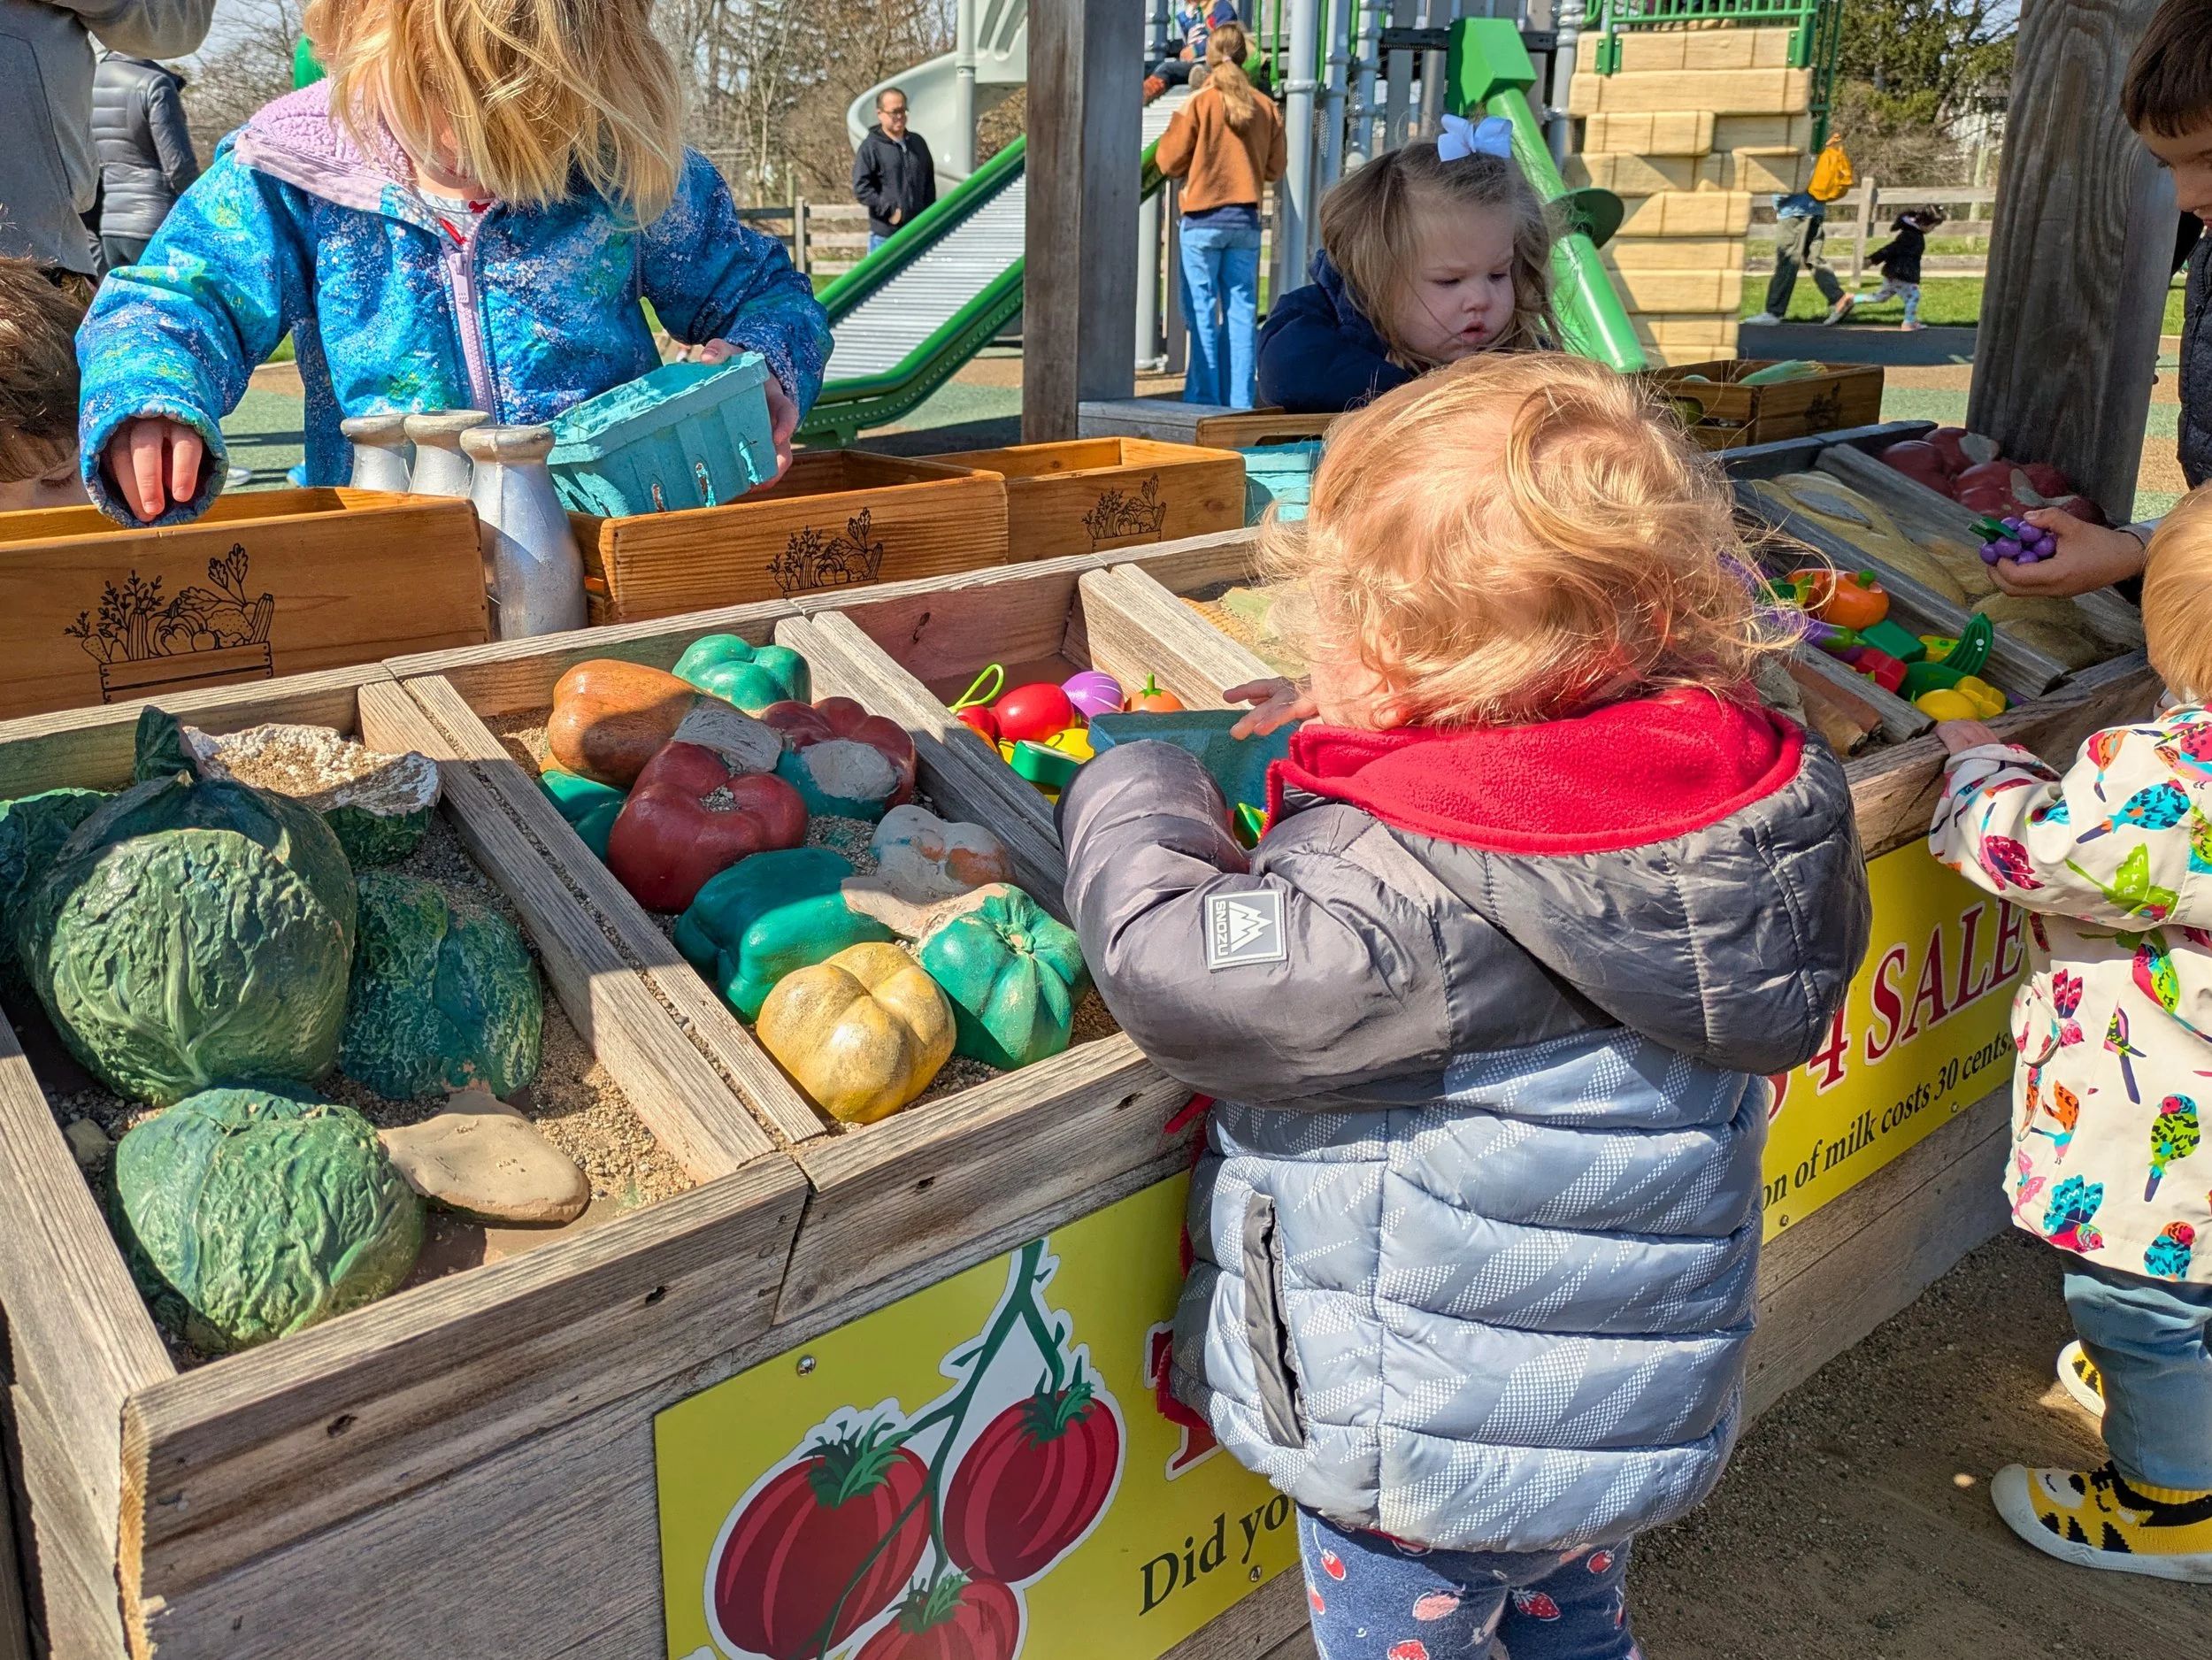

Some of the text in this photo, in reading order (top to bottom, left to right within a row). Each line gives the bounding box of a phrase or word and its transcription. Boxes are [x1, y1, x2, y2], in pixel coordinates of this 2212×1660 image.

[1215, 900, 1229, 957] SNOZU
[1866, 897, 2024, 1062] SALE
[1139, 1511, 1227, 1617] Did
[1240, 1493, 1296, 1564] yo
[1793, 1139, 1824, 1189] of
[1823, 1109, 1878, 1173] milk
[1880, 1081, 1931, 1134] costs
[1934, 1057, 1959, 1101] 30
